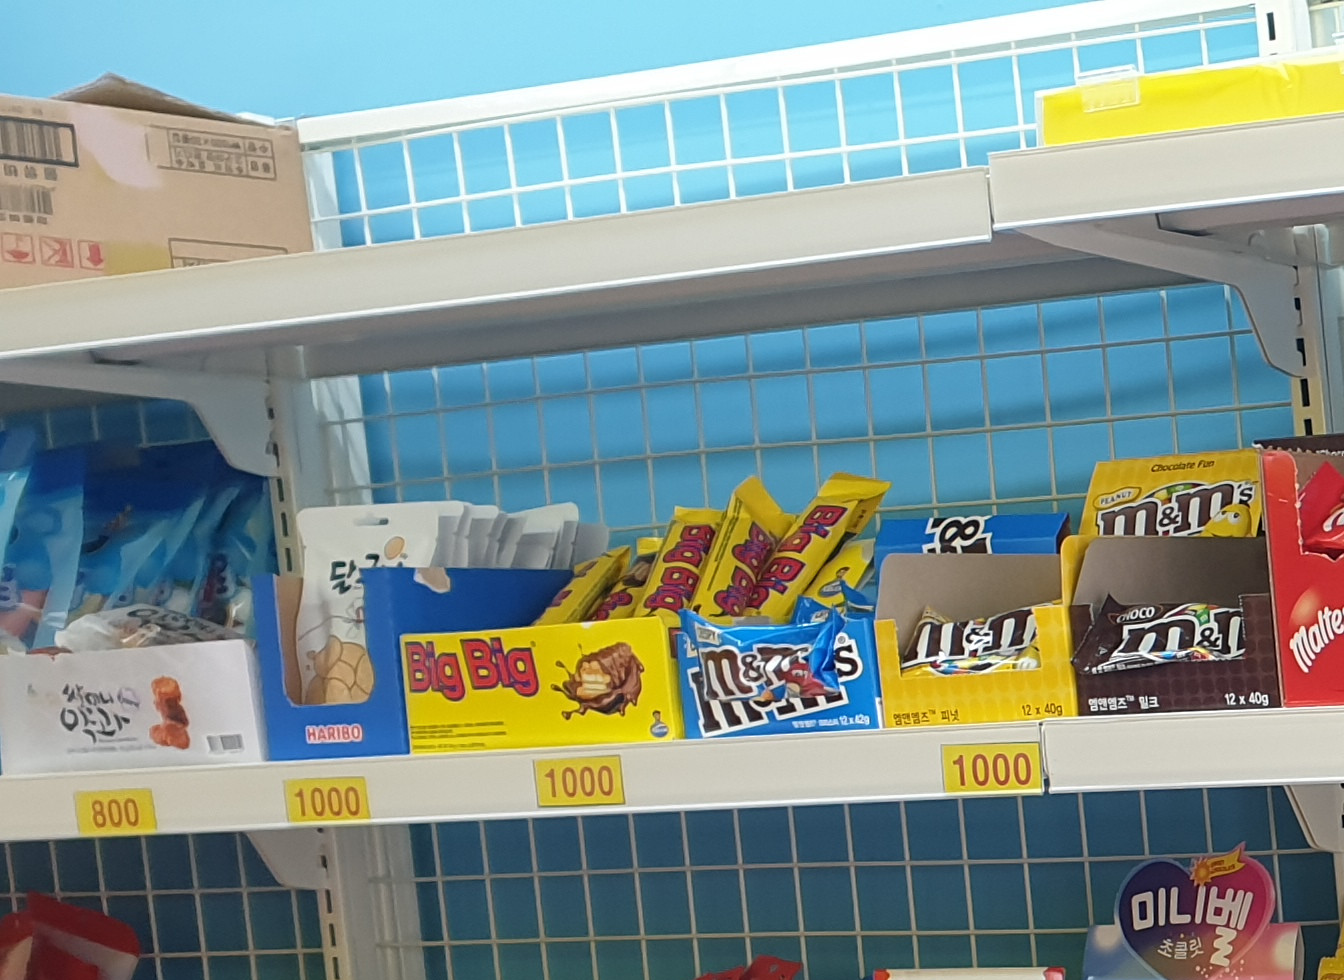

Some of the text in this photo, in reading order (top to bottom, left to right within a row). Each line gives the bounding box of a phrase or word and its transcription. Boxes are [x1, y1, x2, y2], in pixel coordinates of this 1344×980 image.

[1099, 490, 1134, 506] PEANUT
[405, 637, 540, 701] Big Big
[1021, 702, 1063, 718] 12 40g
[1224, 692, 1269, 707] 12 40g
[941, 708, 960, 723] 피넛
[306, 725, 363, 743] HARIBO
[544, 764, 615, 798] 1000
[952, 752, 1032, 787] 1000
[92, 798, 140, 829] 800
[294, 786, 362, 818] 1000
[1131, 886, 1254, 967] 미니벨
